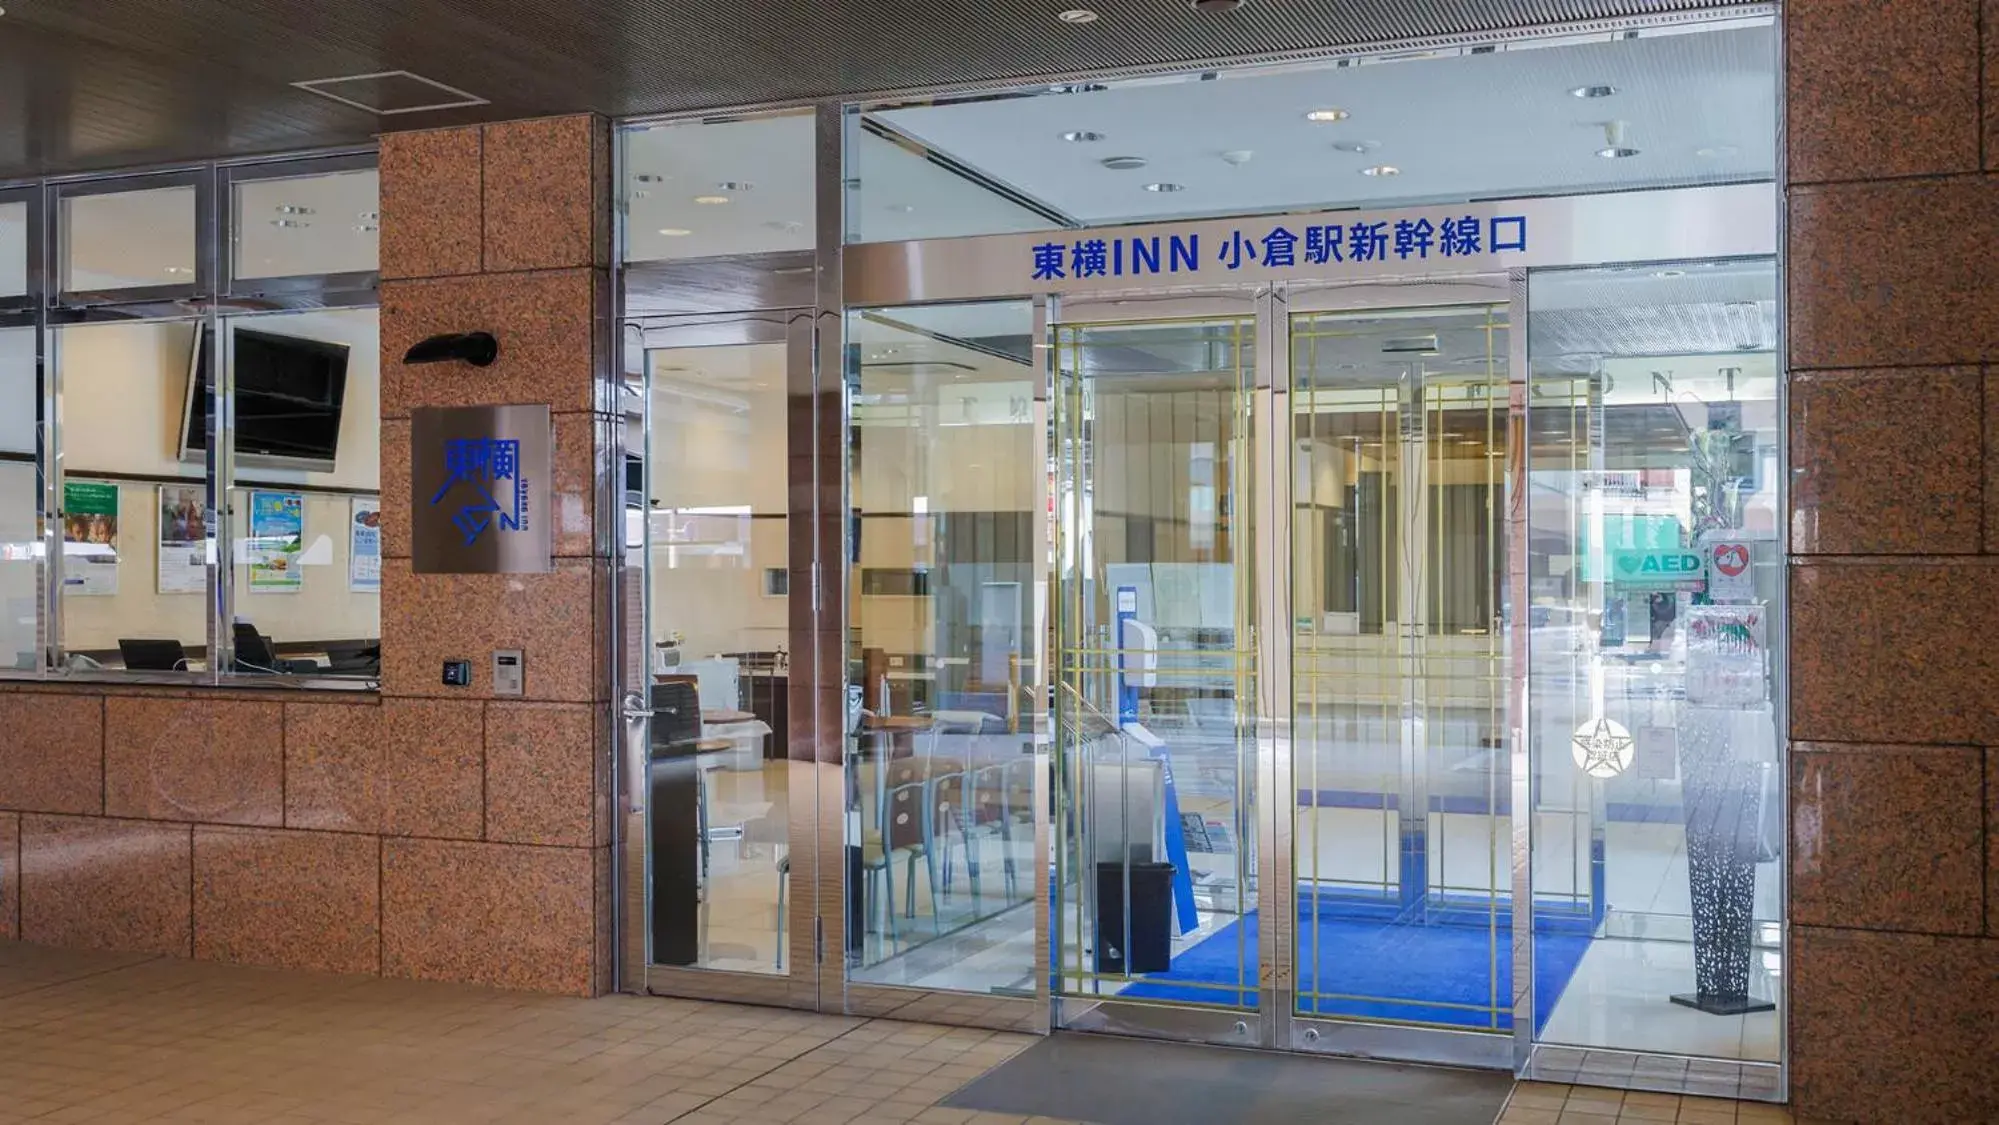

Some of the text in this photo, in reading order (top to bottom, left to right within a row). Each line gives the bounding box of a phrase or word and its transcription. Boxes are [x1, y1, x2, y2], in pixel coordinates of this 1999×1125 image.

[1031, 214, 1527, 281] 東横INN 小倉駅新幹線口
[1641, 554, 1701, 572] AED
